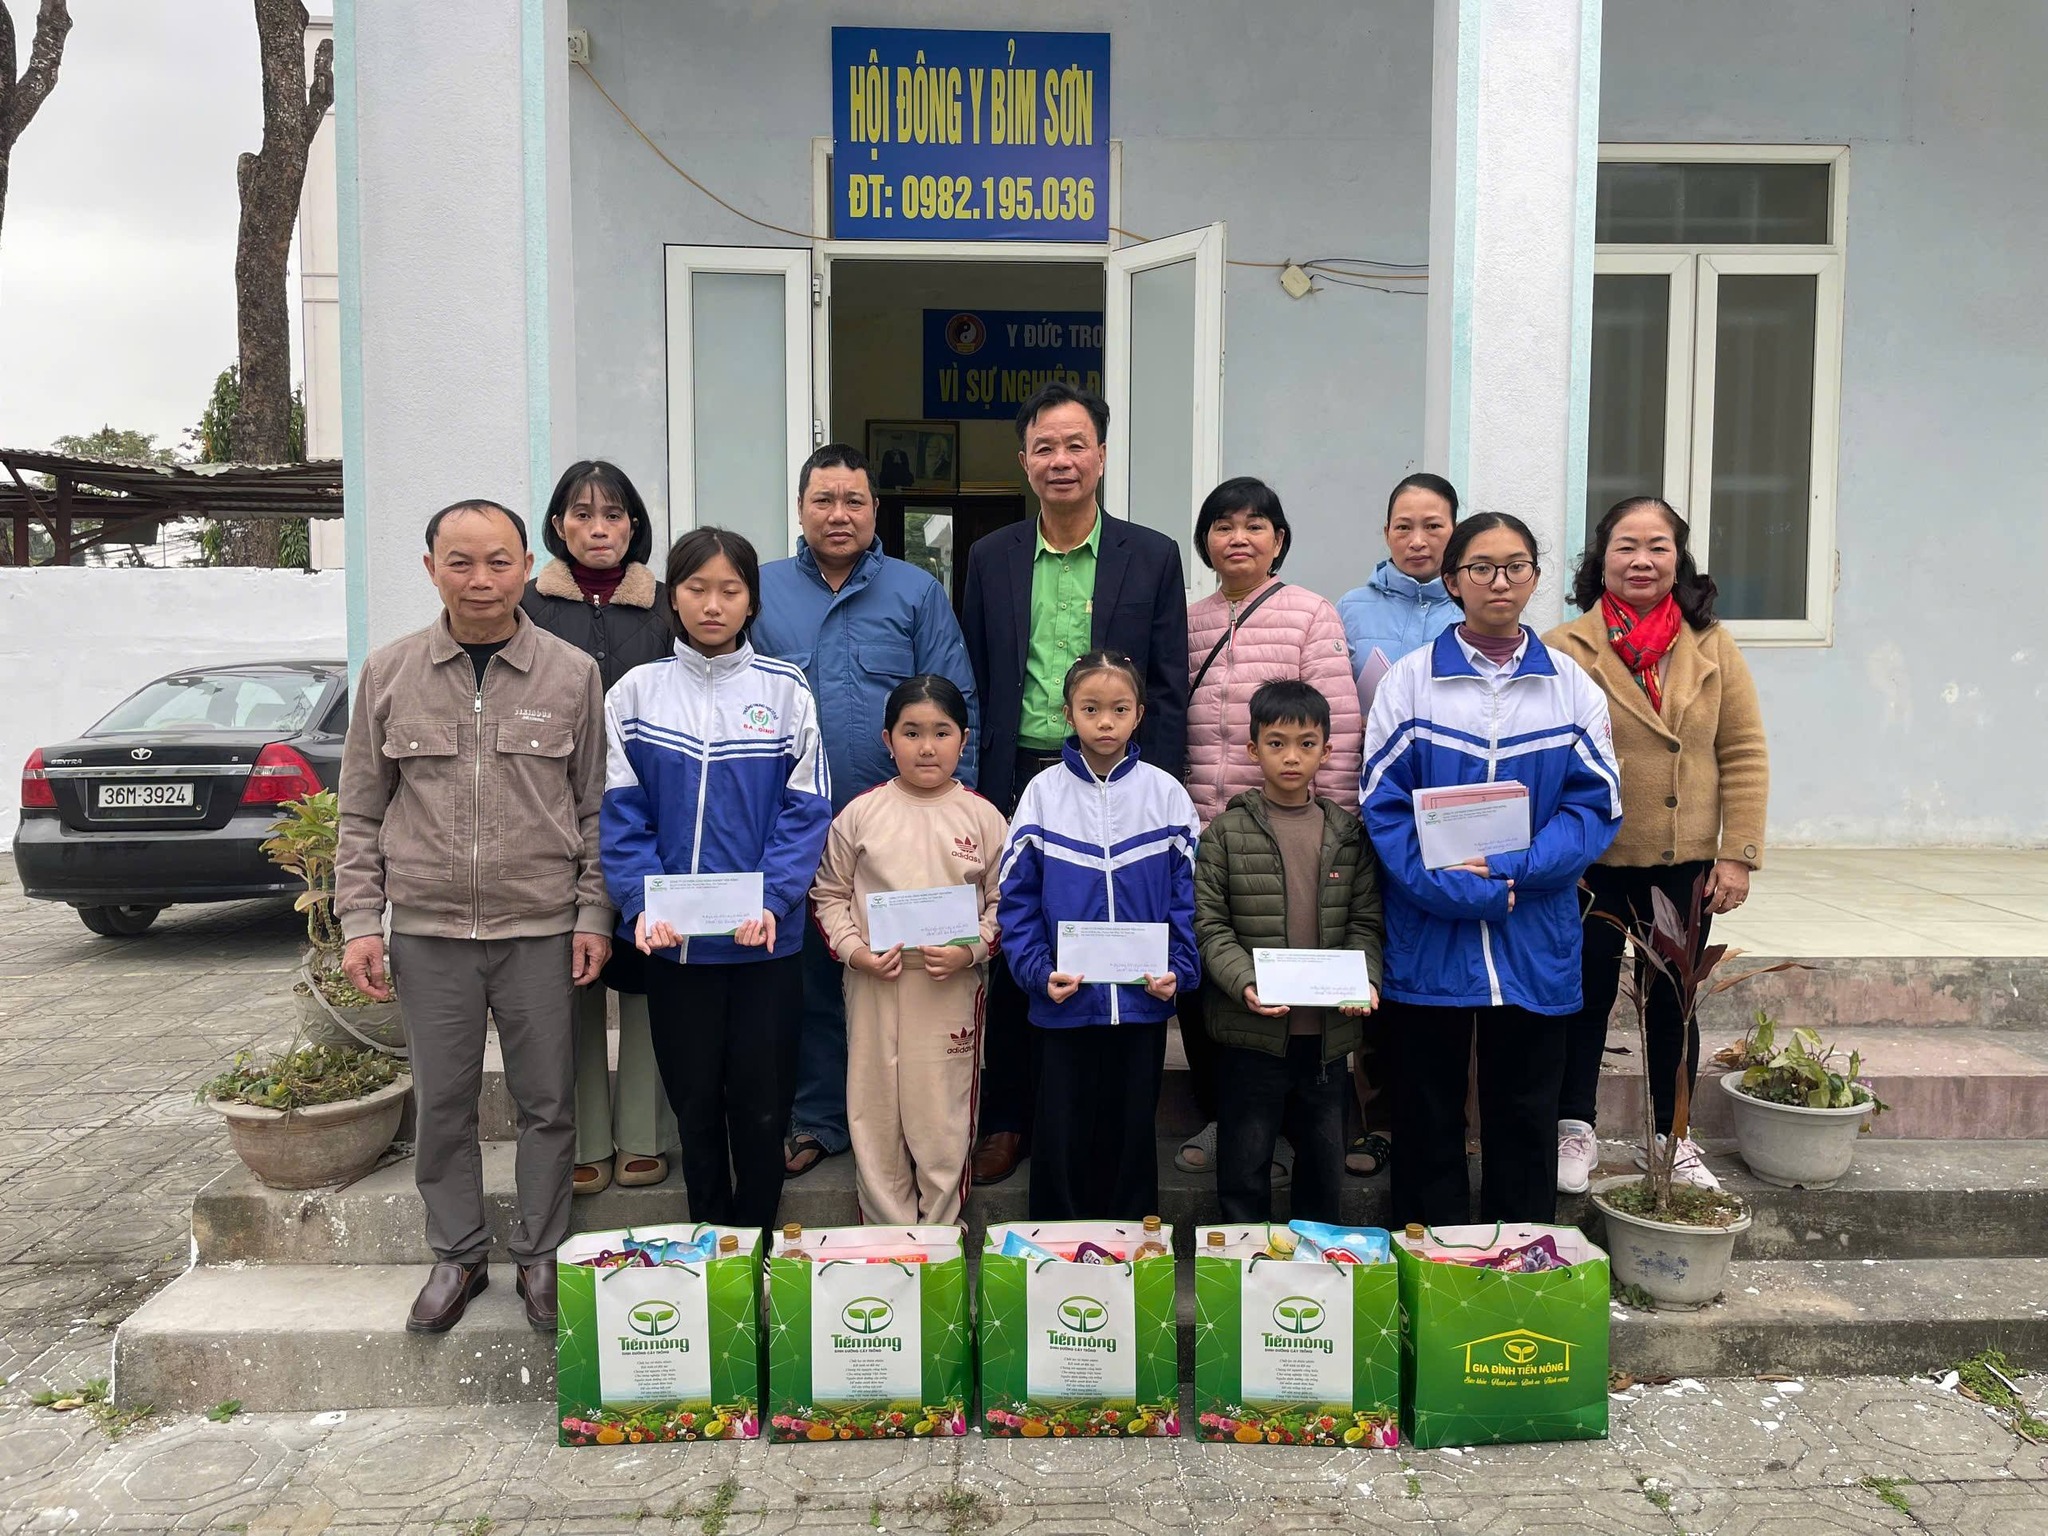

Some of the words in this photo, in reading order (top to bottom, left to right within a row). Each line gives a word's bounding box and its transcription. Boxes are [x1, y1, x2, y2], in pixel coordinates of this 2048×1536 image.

[850, 49, 889, 160] HỘI
[896, 50, 962, 144] ĐÔNG
[969, 68, 984, 145] Y
[991, 39, 1036, 146] BỈM
[1044, 64, 1093, 146] SƠN
[849, 174, 893, 218] ĐT:
[902, 175, 1095, 220] 0982.195.036
[1007, 324, 1018, 347] Y
[1024, 318, 1063, 348] ĐỨC
[939, 362, 959, 403] VÌ
[966, 365, 998, 410] SỰ
[104, 786, 186, 804] 36M-3924
[1472, 1363, 1490, 1374] GIA
[1491, 1362, 1516, 1375] ĐÌNH
[1517, 1363, 1537, 1375] TIẾN
[1539, 1362, 1564, 1374] NÔNG
